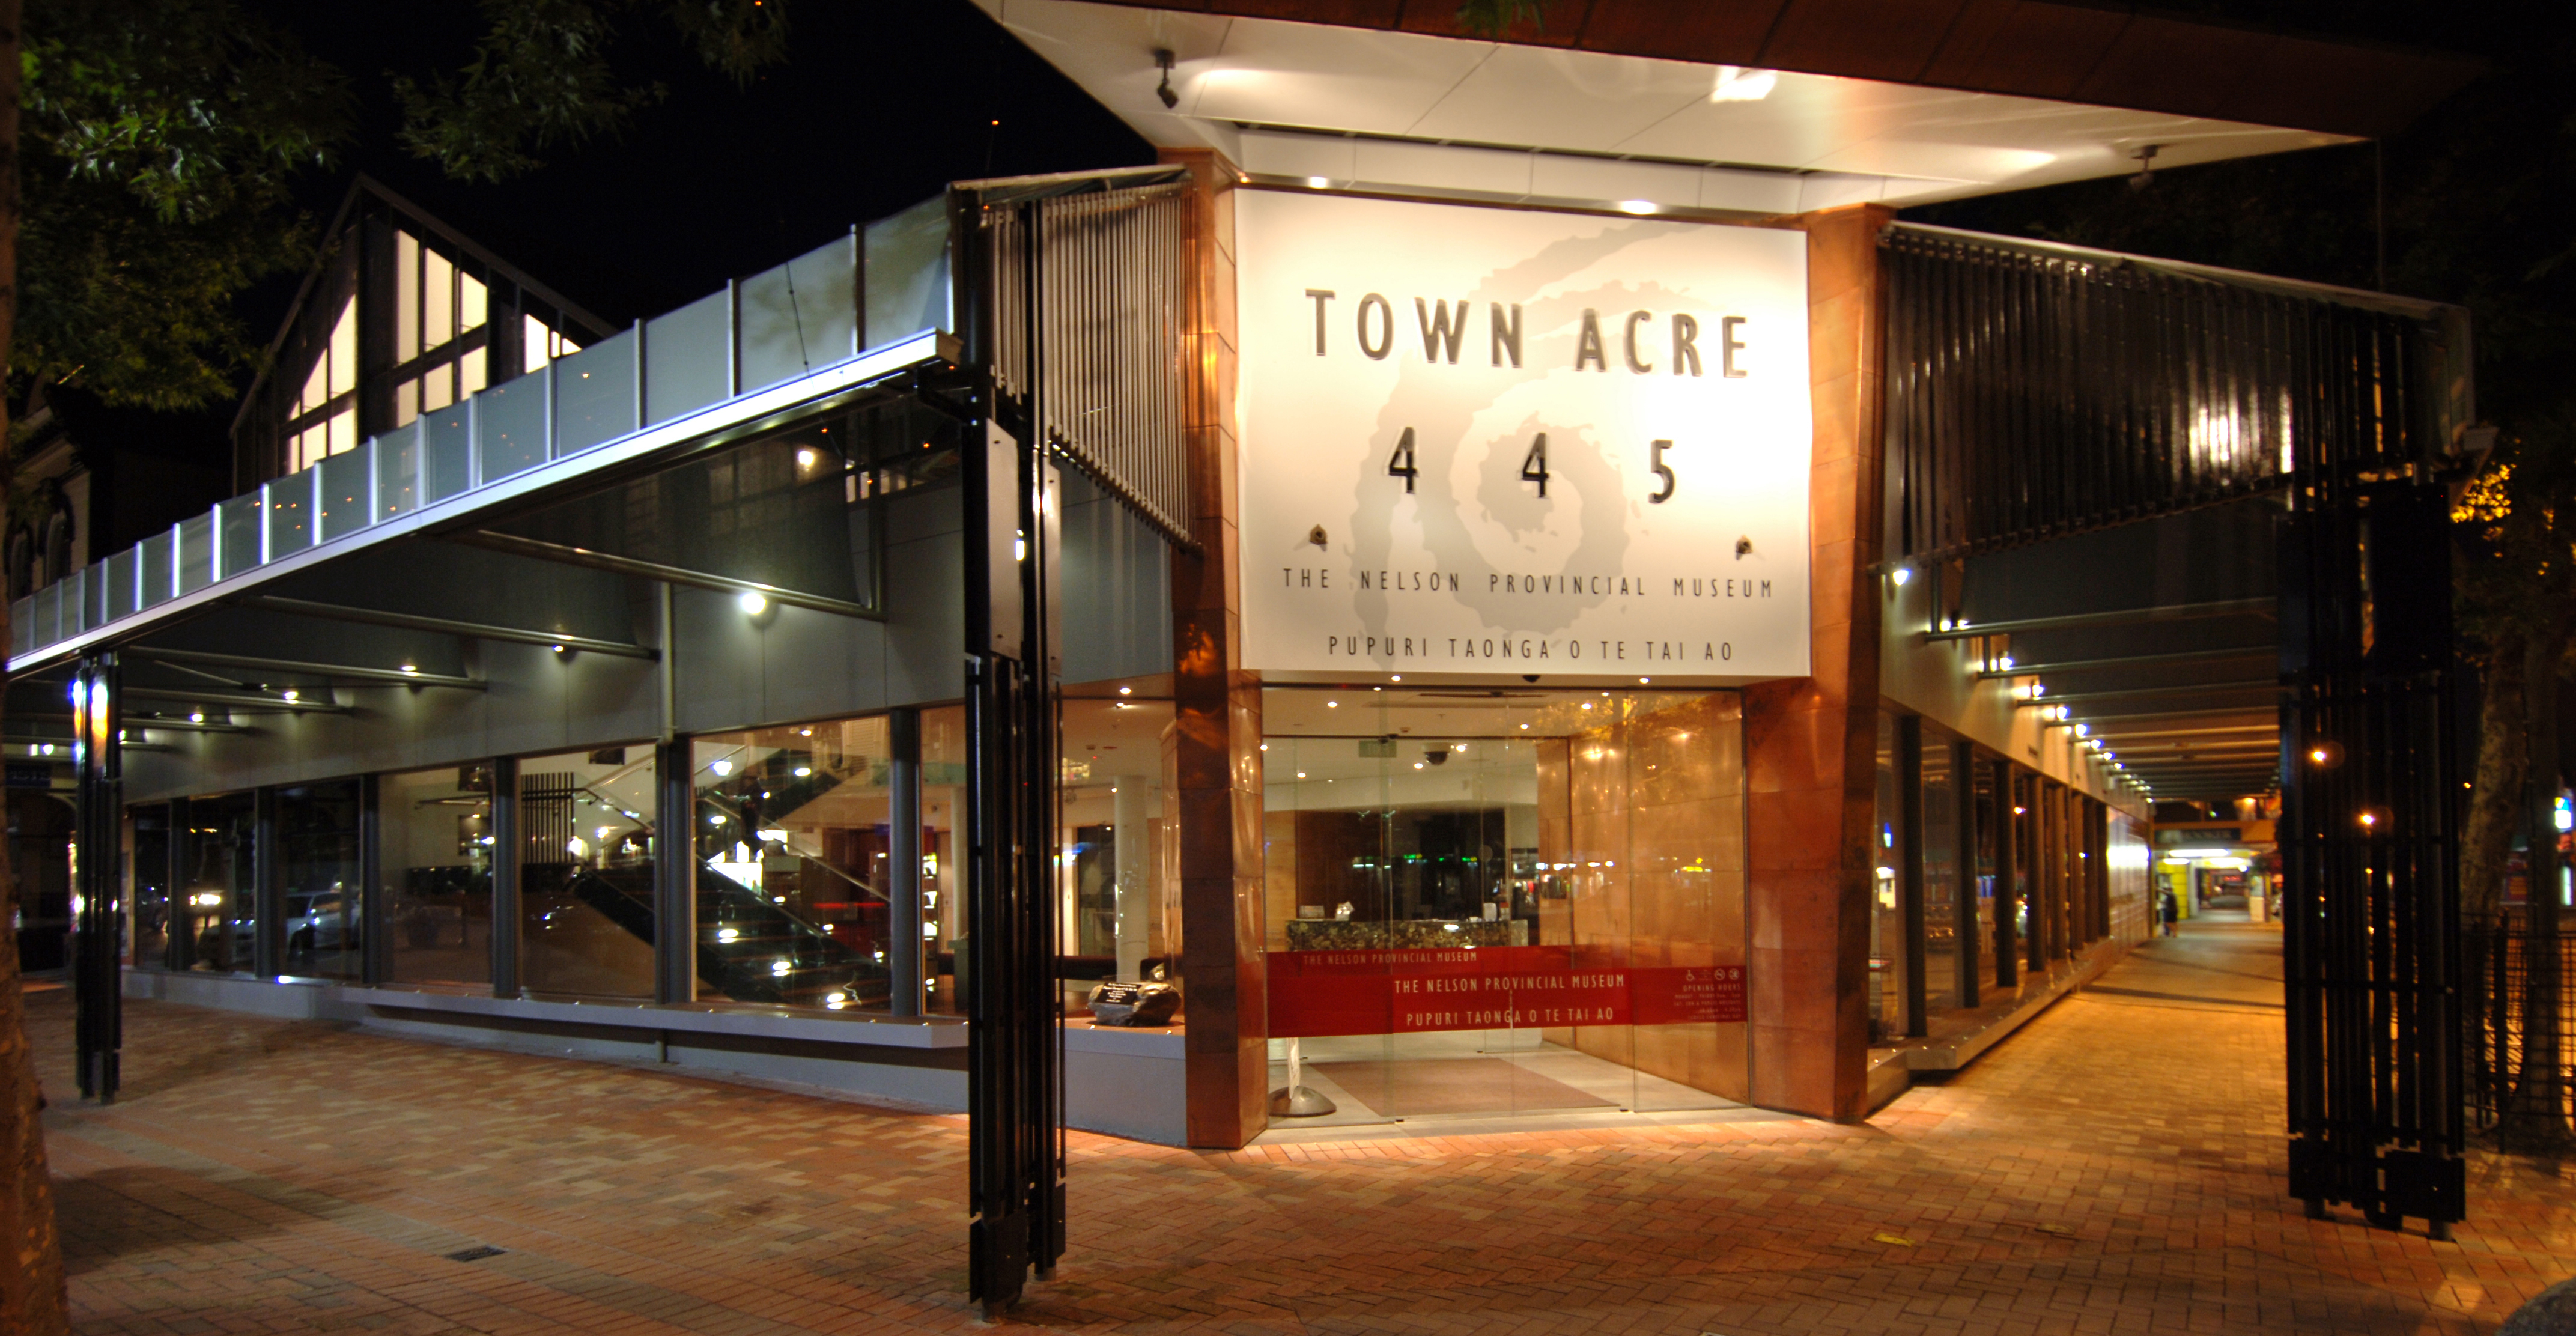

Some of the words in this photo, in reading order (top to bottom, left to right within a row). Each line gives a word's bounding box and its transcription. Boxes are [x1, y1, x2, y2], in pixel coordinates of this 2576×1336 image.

[1305, 288, 1523, 369] TOWN
[1574, 308, 1748, 378] ACRE
[1387, 426, 1419, 495] 4
[1519, 432, 1551, 499] 4
[1648, 439, 1676, 505] 5
[1283, 568, 1329, 588] THE
[1361, 570, 1459, 592] NELSON
[1490, 574, 1645, 596] PROVINCIAL
[1674, 578, 1772, 598] MUSEUM
[1329, 636, 1427, 657] PUPURI
[1448, 638, 1549, 659] TAONGA
[1570, 640, 1581, 660] O
[1600, 640, 1626, 660] TE
[1645, 641, 1684, 661] TAI
[1704, 642, 1732, 661] AO
[1304, 955, 1322, 965] THE
[1327, 954, 1367, 965] NELSON
[1372, 952, 1432, 964] PROVINCIAL
[1436, 951, 1477, 962] MUSEUM
[1394, 979, 1420, 994] THE
[1426, 978, 1478, 993] NELSON
[1484, 976, 1566, 991] PROVINCIAL
[1571, 974, 1625, 989] MUSEUM
[1406, 1012, 1459, 1027] PUPURI
[1466, 1010, 1522, 1025] TAONGA
[1528, 1009, 1537, 1023] O
[1545, 1008, 1560, 1022] TE
[1567, 1007, 1590, 1022] TAI
[1597, 1007, 1614, 1021] AO
